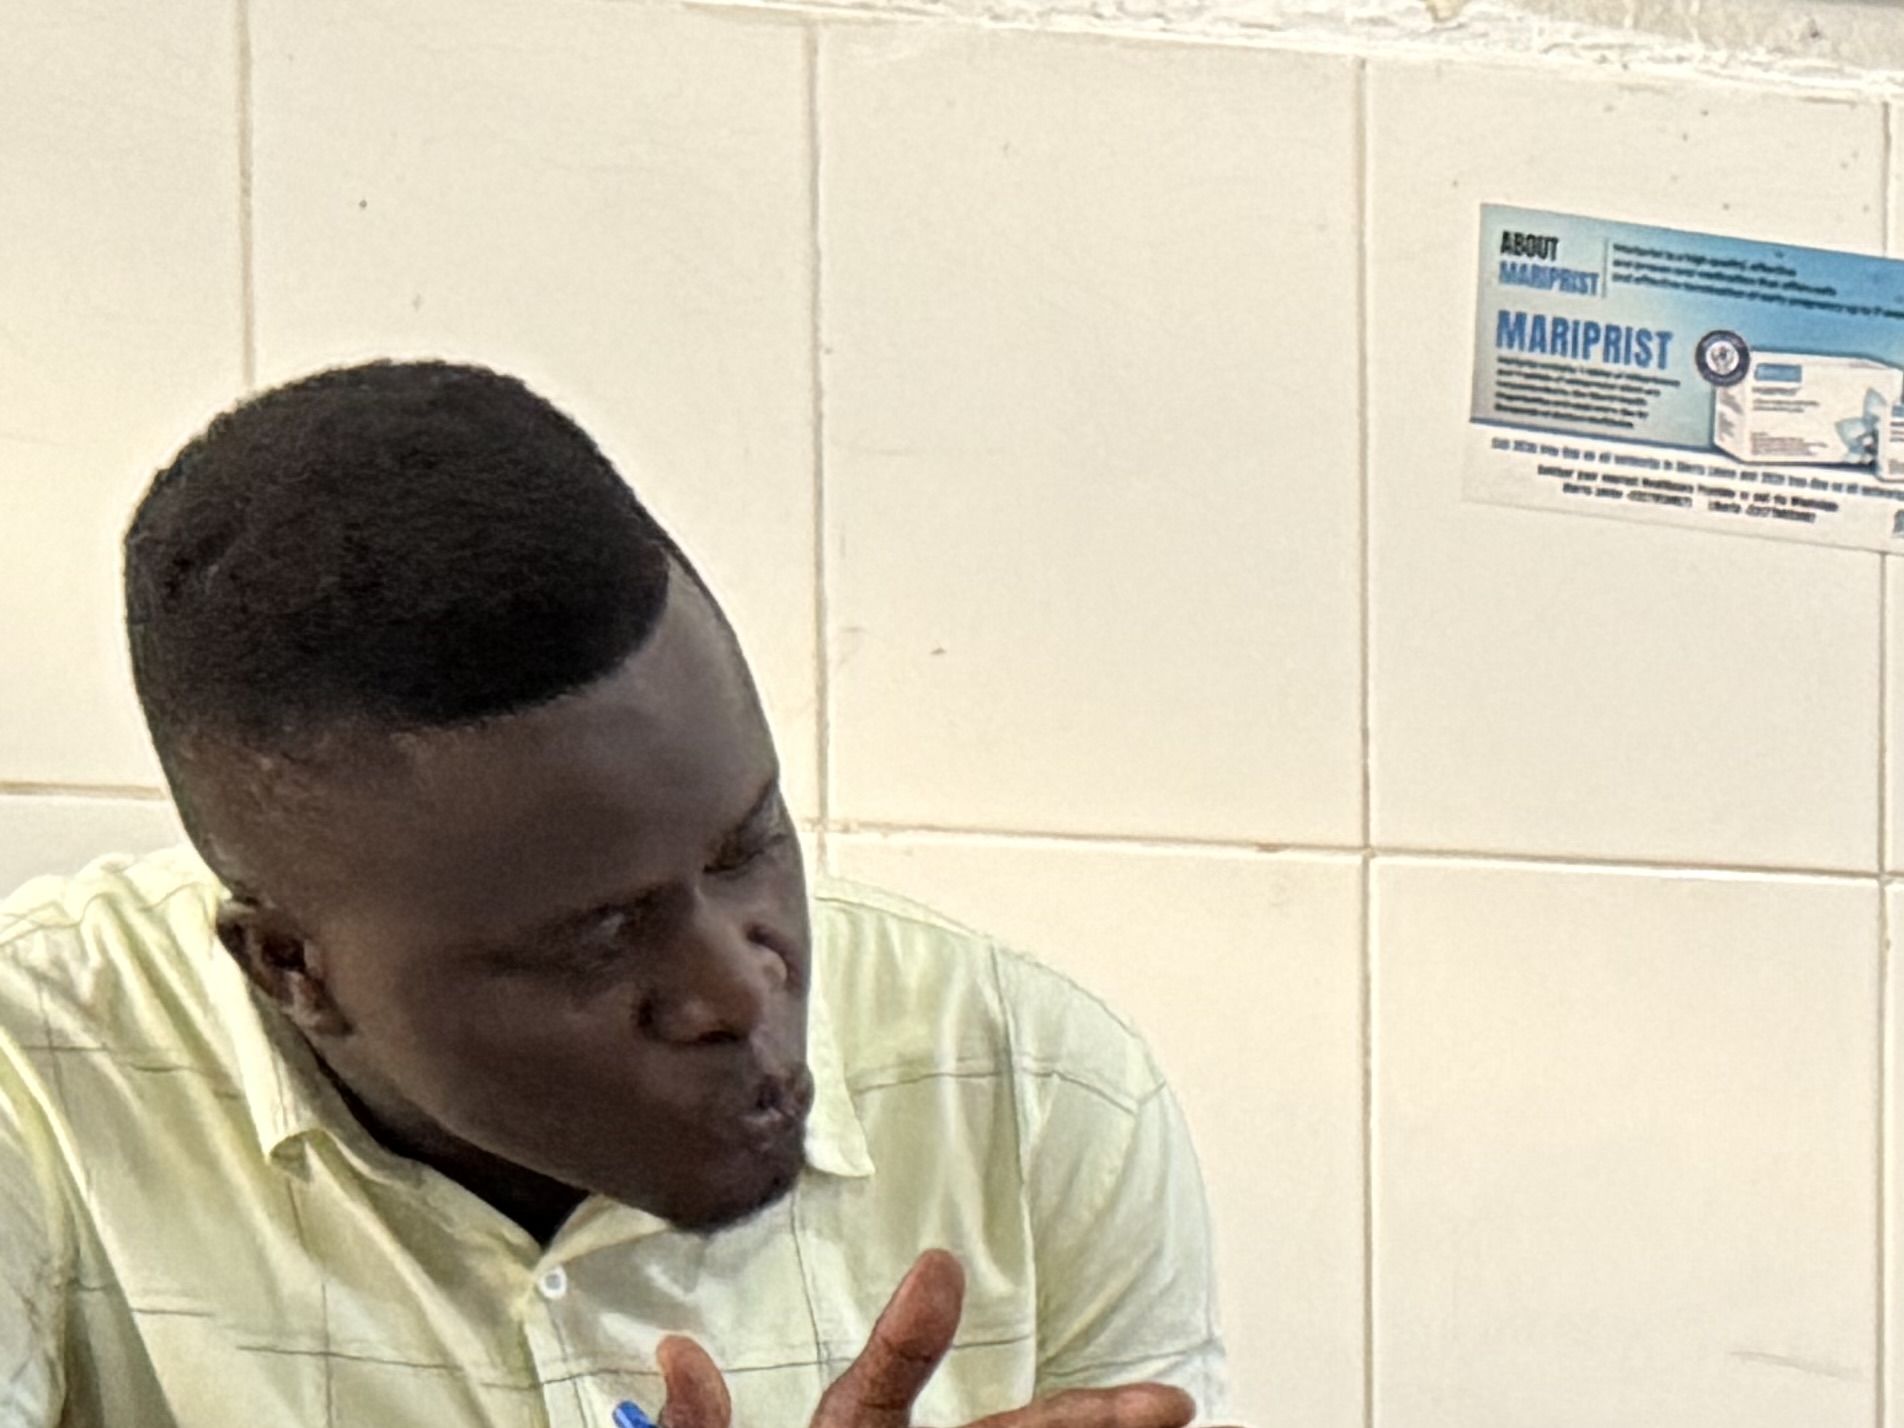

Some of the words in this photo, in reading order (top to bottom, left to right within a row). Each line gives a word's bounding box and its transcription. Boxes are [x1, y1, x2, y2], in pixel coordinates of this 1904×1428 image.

[1501, 230, 1559, 261] ABOUT
[1499, 260, 1600, 296] MARIPRIST
[1496, 310, 1674, 370] MARIPRIST
